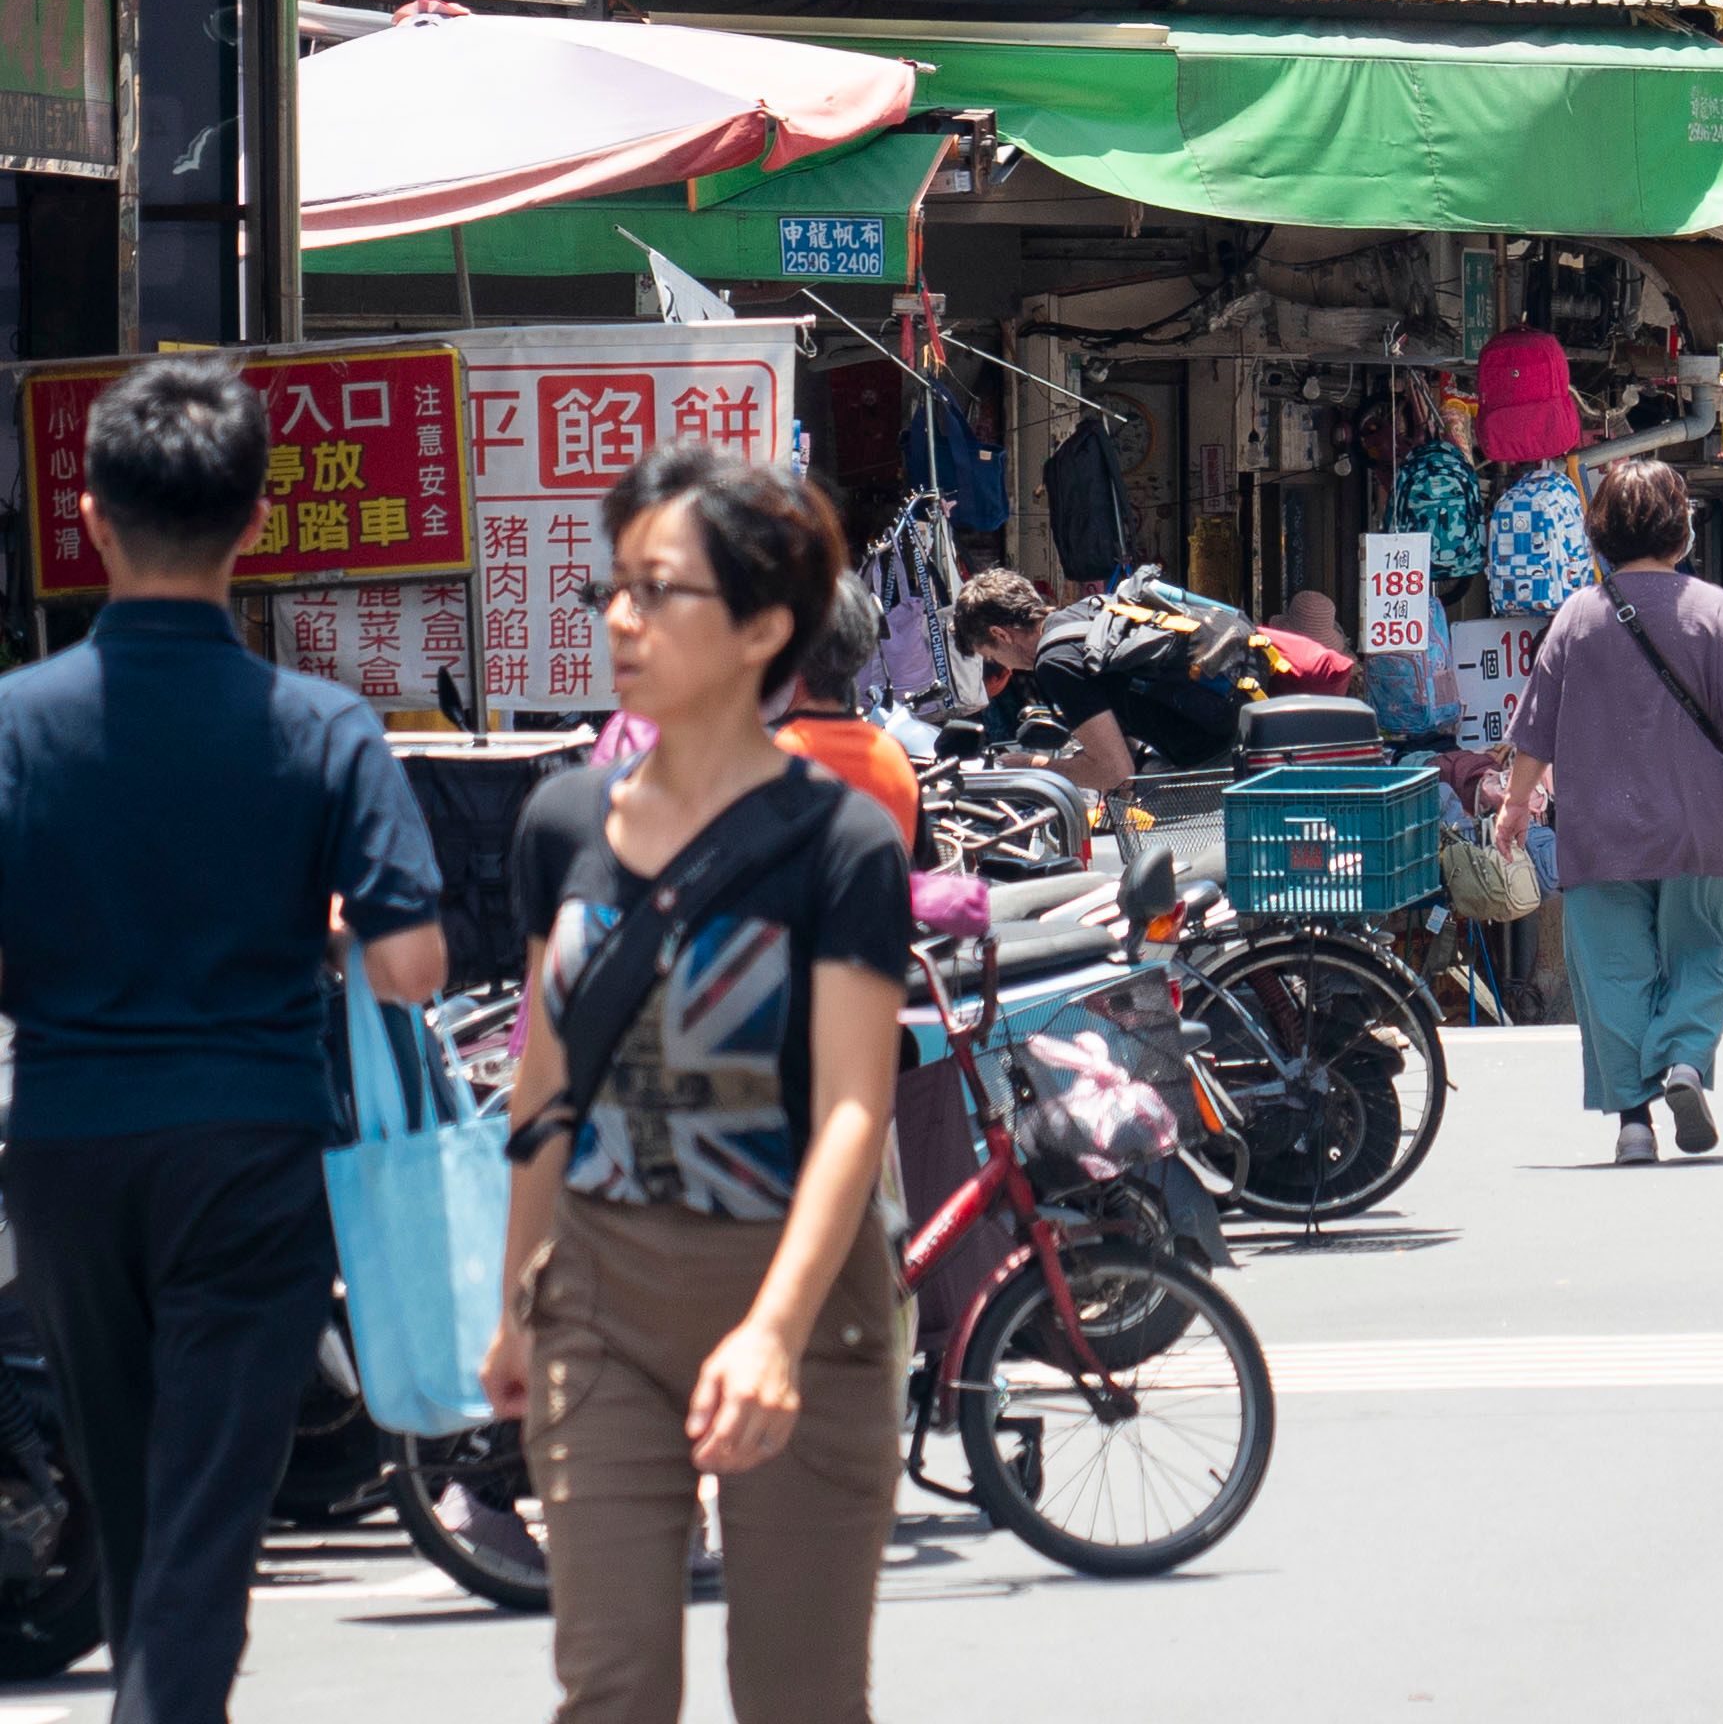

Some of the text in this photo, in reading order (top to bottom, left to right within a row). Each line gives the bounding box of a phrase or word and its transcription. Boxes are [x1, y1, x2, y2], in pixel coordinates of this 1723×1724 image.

[782, 218, 883, 251] 申龍帆布
[413, 383, 449, 538] 注意安全
[47, 402, 82, 561] 小心地滑
[1384, 549, 1410, 570] 1個
[1370, 569, 1424, 597] 188
[483, 513, 530, 697] 豬肉餡餅
[547, 513, 593, 697] 牛肉餡餅
[1382, 599, 1409, 620] 2個
[1370, 619, 1423, 647] 350
[1457, 648, 1500, 681] 一個
[1461, 711, 1502, 743] 二個
